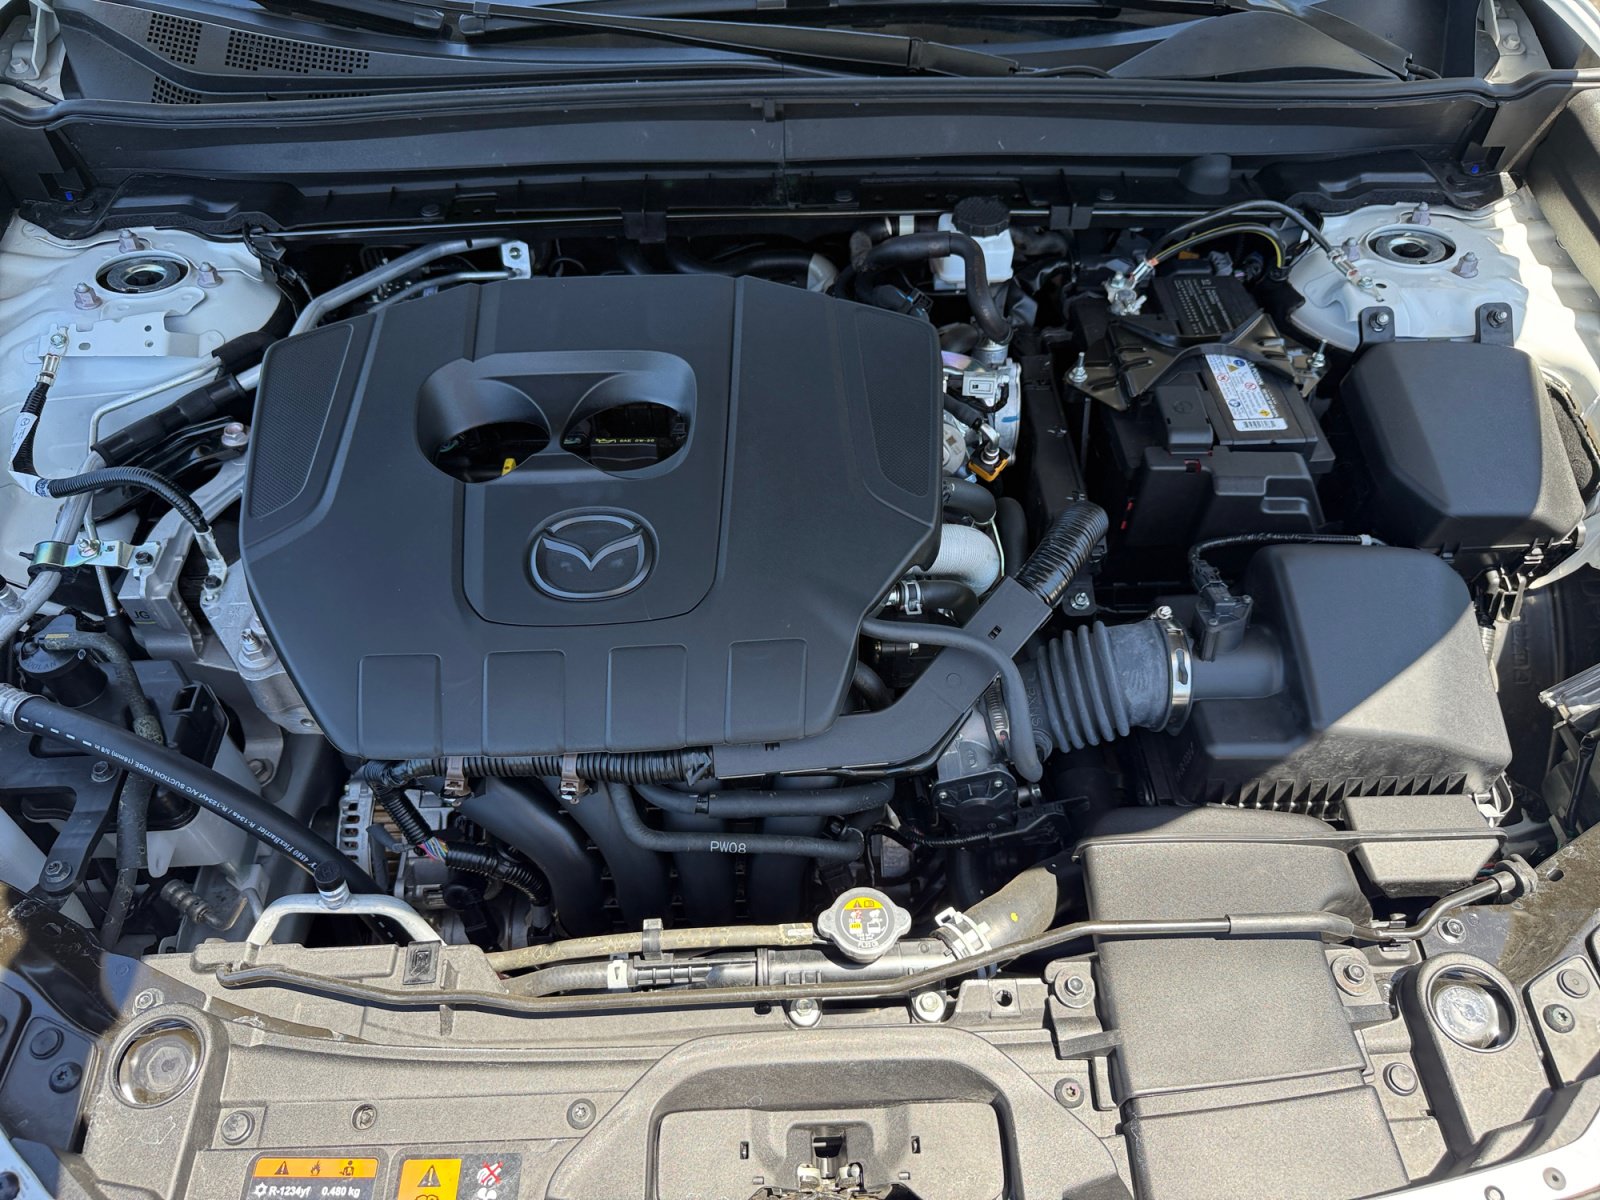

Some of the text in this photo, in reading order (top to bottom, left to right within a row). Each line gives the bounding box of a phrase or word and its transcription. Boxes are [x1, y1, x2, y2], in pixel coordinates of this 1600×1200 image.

[134, 761, 154, 775] HOSE
[155, 770, 186, 790] SUCTION
[186, 785, 199, 796] A/C
[257, 826, 295, 853] FlexBarrier
[710, 840, 747, 854] PW08
[268, 1185, 361, 1198] R-1234yf 0.480 kg
